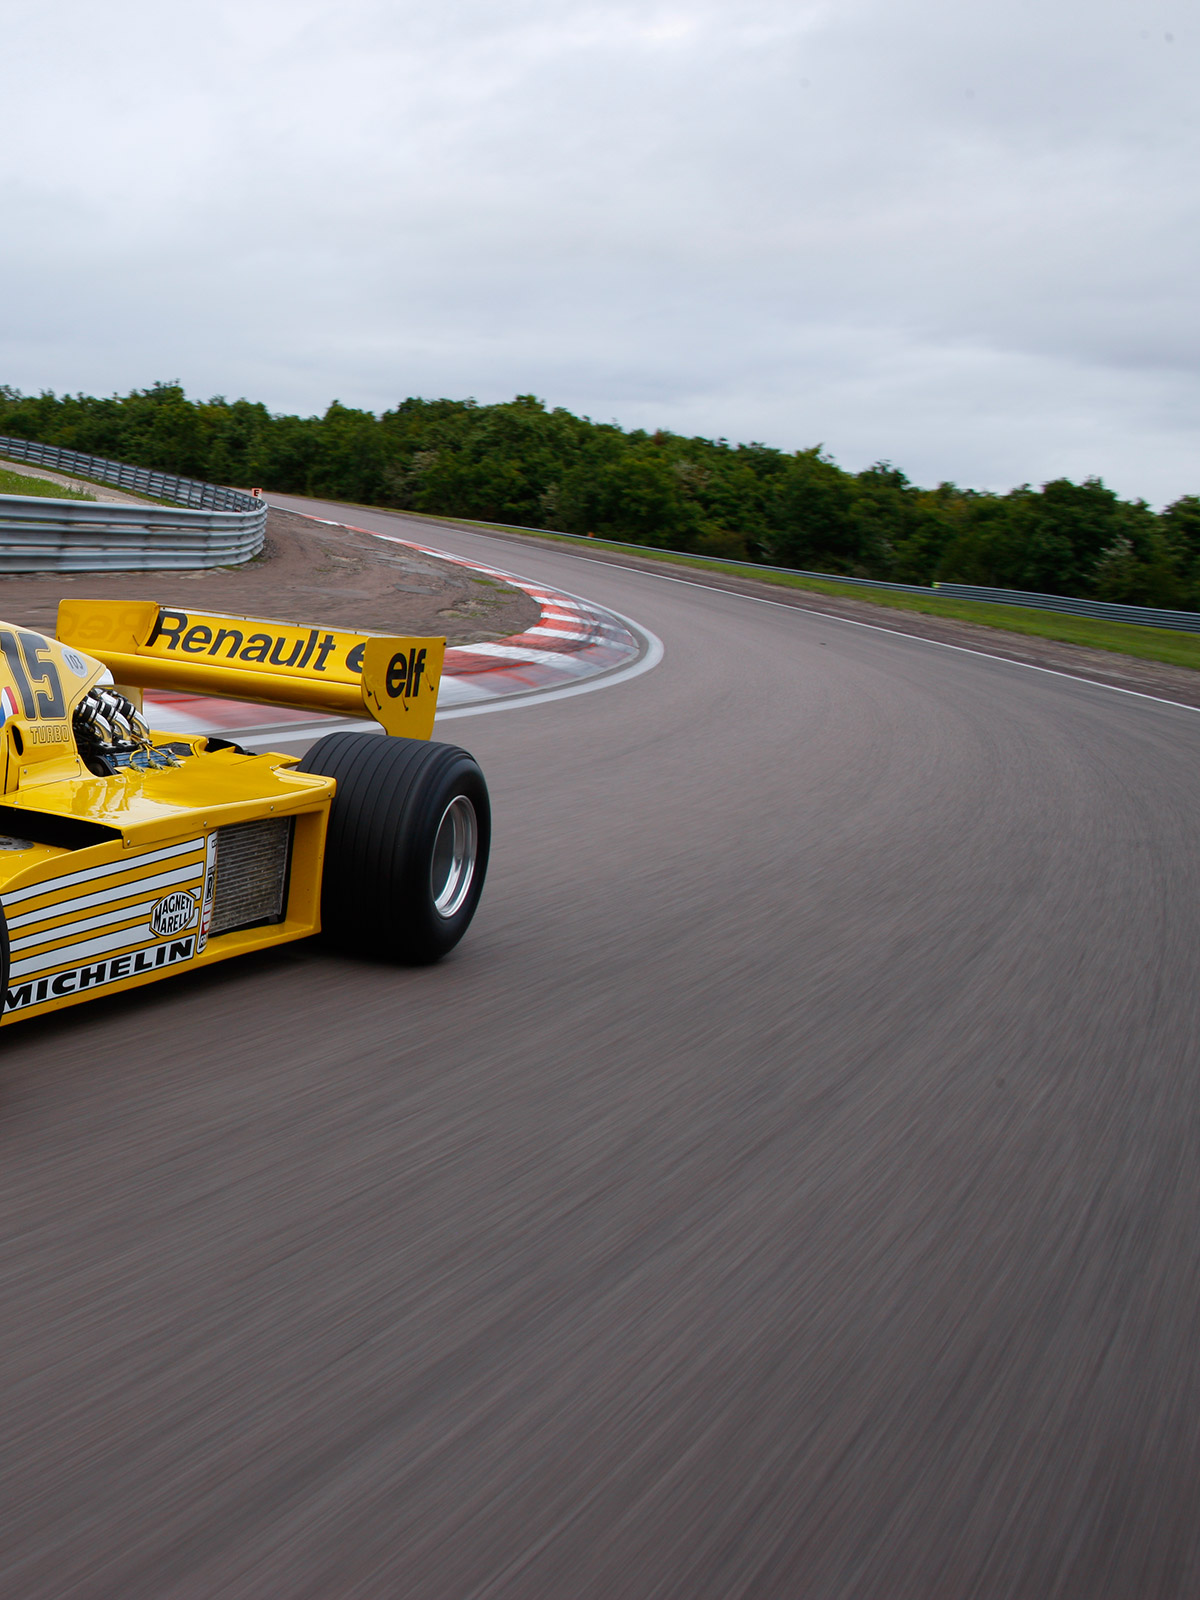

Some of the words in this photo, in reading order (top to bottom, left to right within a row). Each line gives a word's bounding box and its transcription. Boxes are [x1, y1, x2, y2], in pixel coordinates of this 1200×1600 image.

[144, 611, 336, 671] Renault
[386, 648, 427, 698] elf
[30, 725, 70, 744] TURBO
[4, 939, 193, 1009] MICHELIN
